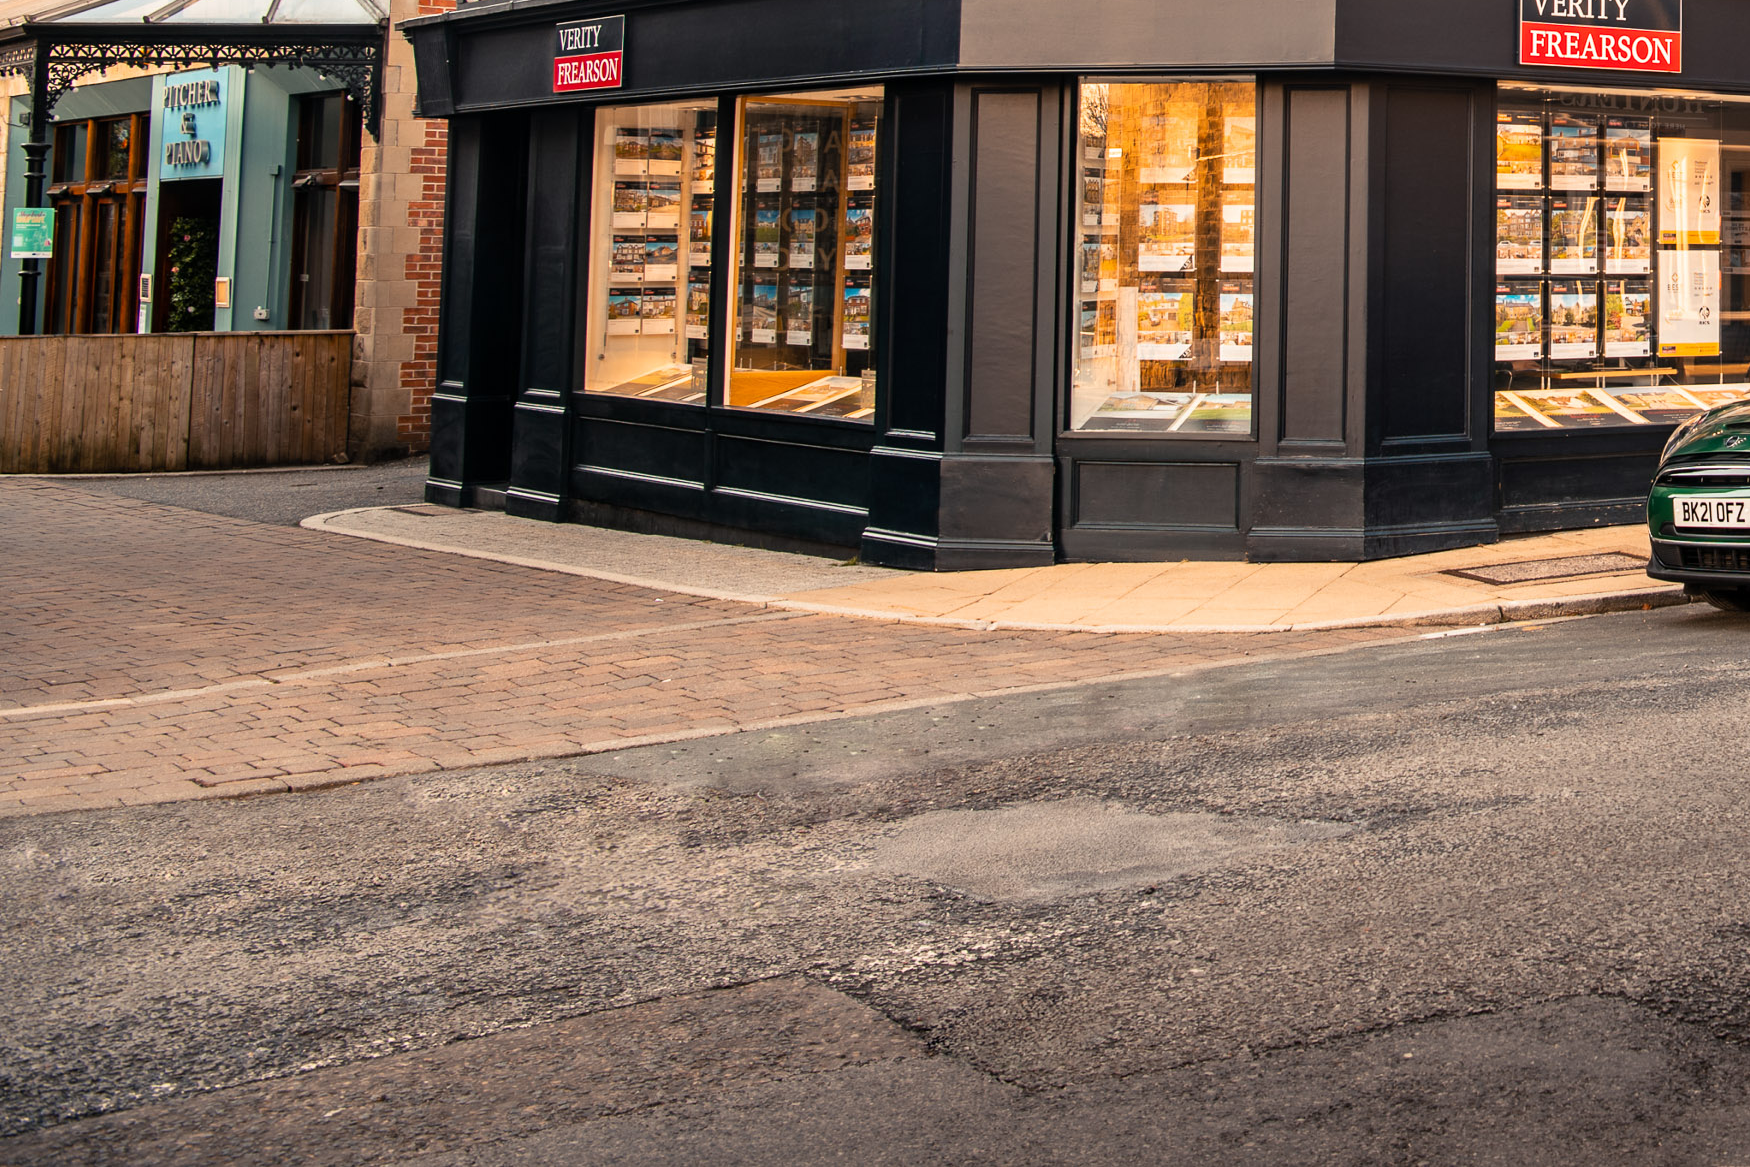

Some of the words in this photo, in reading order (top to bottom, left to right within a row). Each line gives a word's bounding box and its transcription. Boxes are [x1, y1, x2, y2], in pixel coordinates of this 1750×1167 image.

[559, 25, 602, 51] VERITY
[1530, 30, 1673, 65] FREARSON
[557, 57, 619, 86] FREARSON
[162, 80, 213, 109] PITCHER
[181, 112, 195, 134] &
[164, 140, 203, 166] PIANO
[1682, 501, 1713, 523] BK21
[1716, 501, 1746, 523] OFZ
